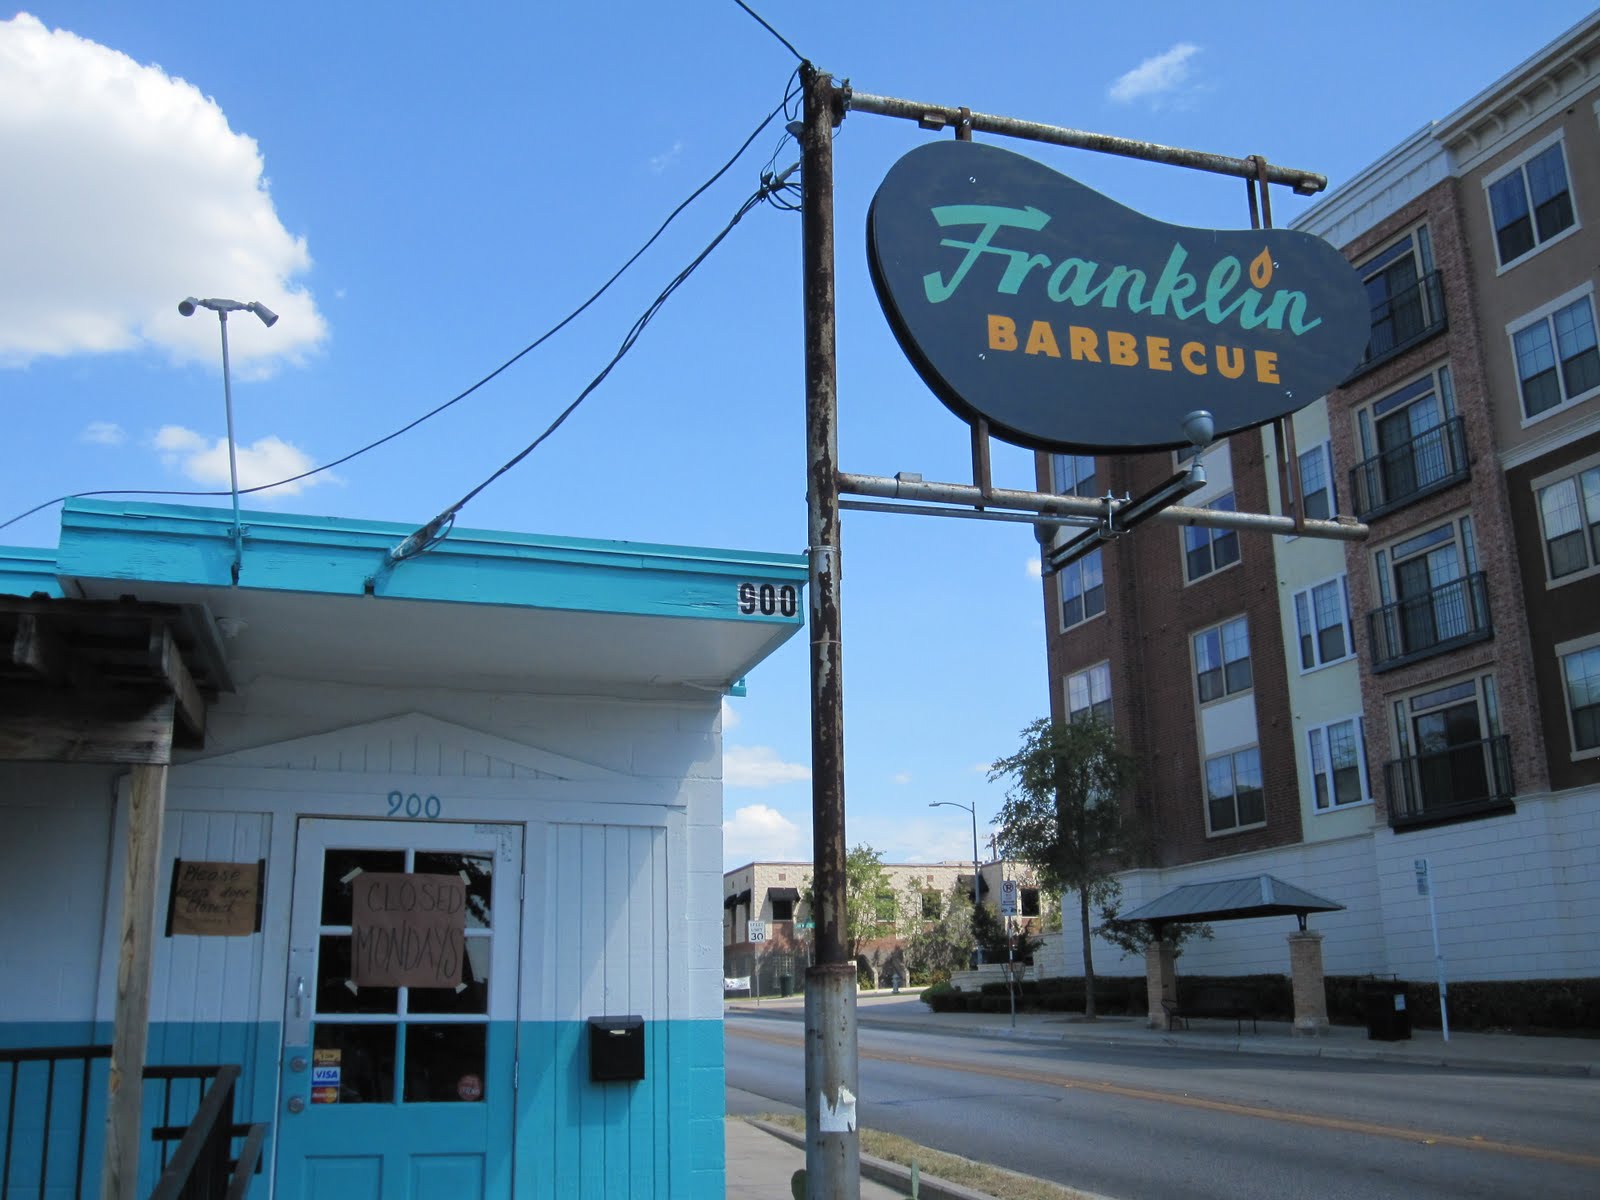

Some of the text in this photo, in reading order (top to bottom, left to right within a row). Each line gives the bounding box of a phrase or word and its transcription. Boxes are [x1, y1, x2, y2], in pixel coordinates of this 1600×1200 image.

[923, 204, 1322, 336] Franklin
[987, 314, 1281, 385] BARBECUE
[739, 582, 797, 618] 900
[388, 790, 441, 819] 900
[367, 879, 463, 915] CLOSED
[355, 920, 464, 981] MONDAYS
[751, 932, 763, 941] 30
[316, 1070, 338, 1079] VISA
